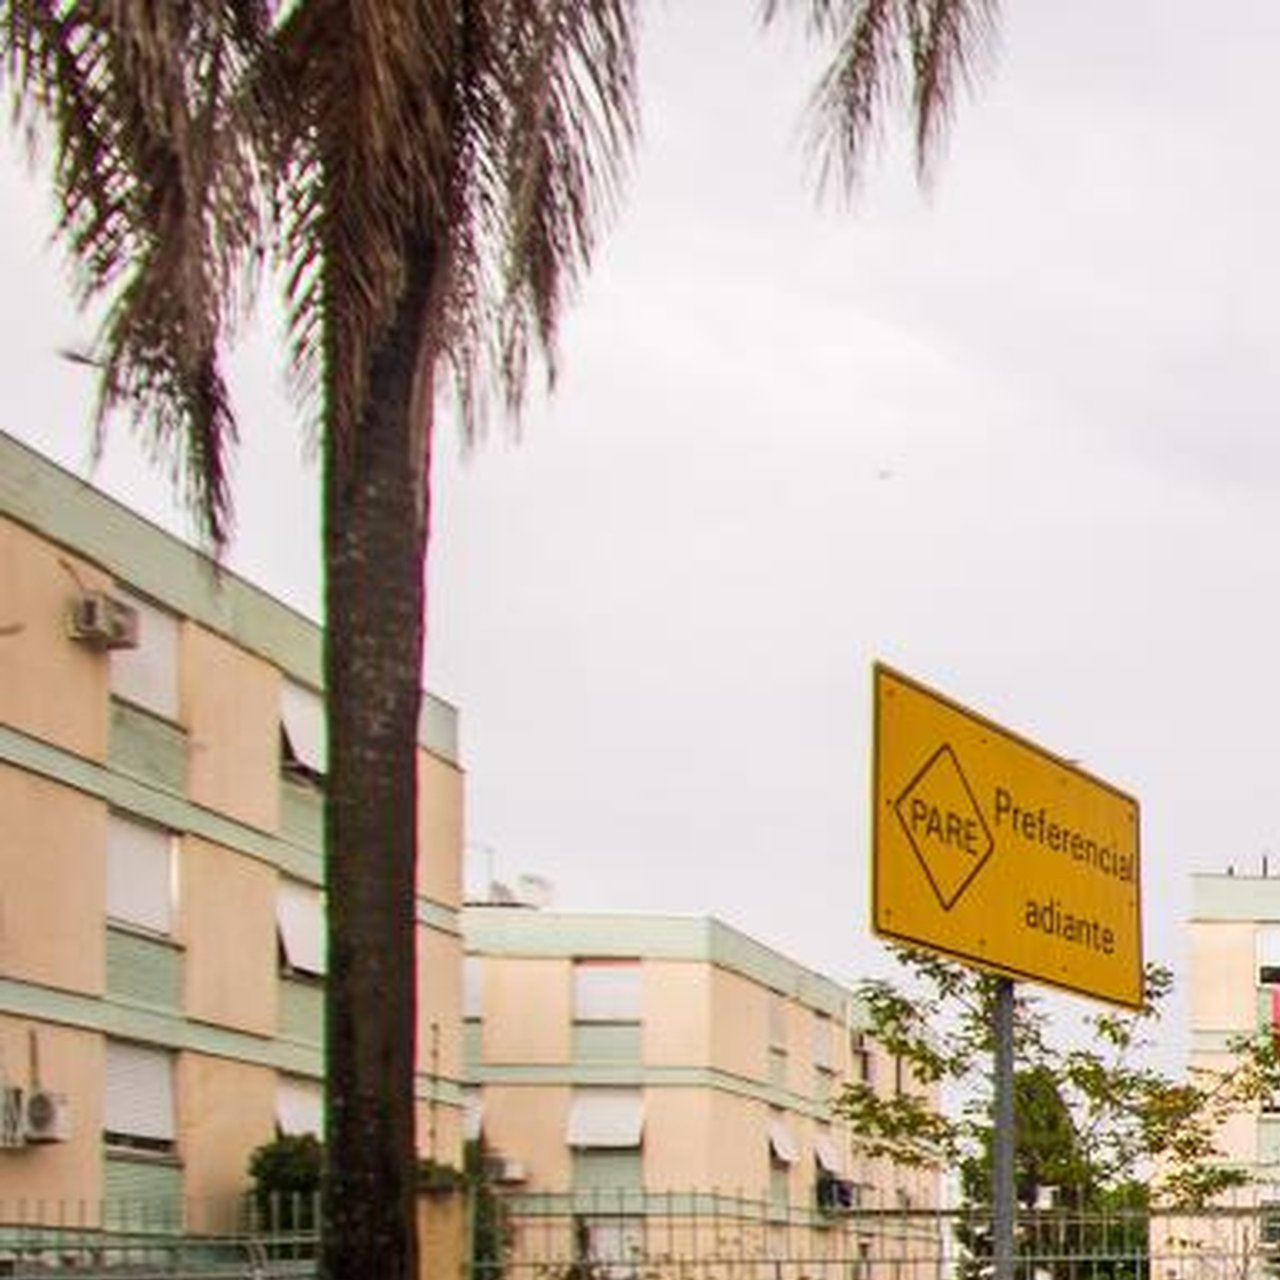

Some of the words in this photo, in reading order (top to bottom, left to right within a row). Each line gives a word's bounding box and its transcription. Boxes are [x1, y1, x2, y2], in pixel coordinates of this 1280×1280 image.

[911, 799, 979, 857] PARE
[994, 788, 1135, 882] Preferencial
[1025, 897, 1115, 955] adiante
